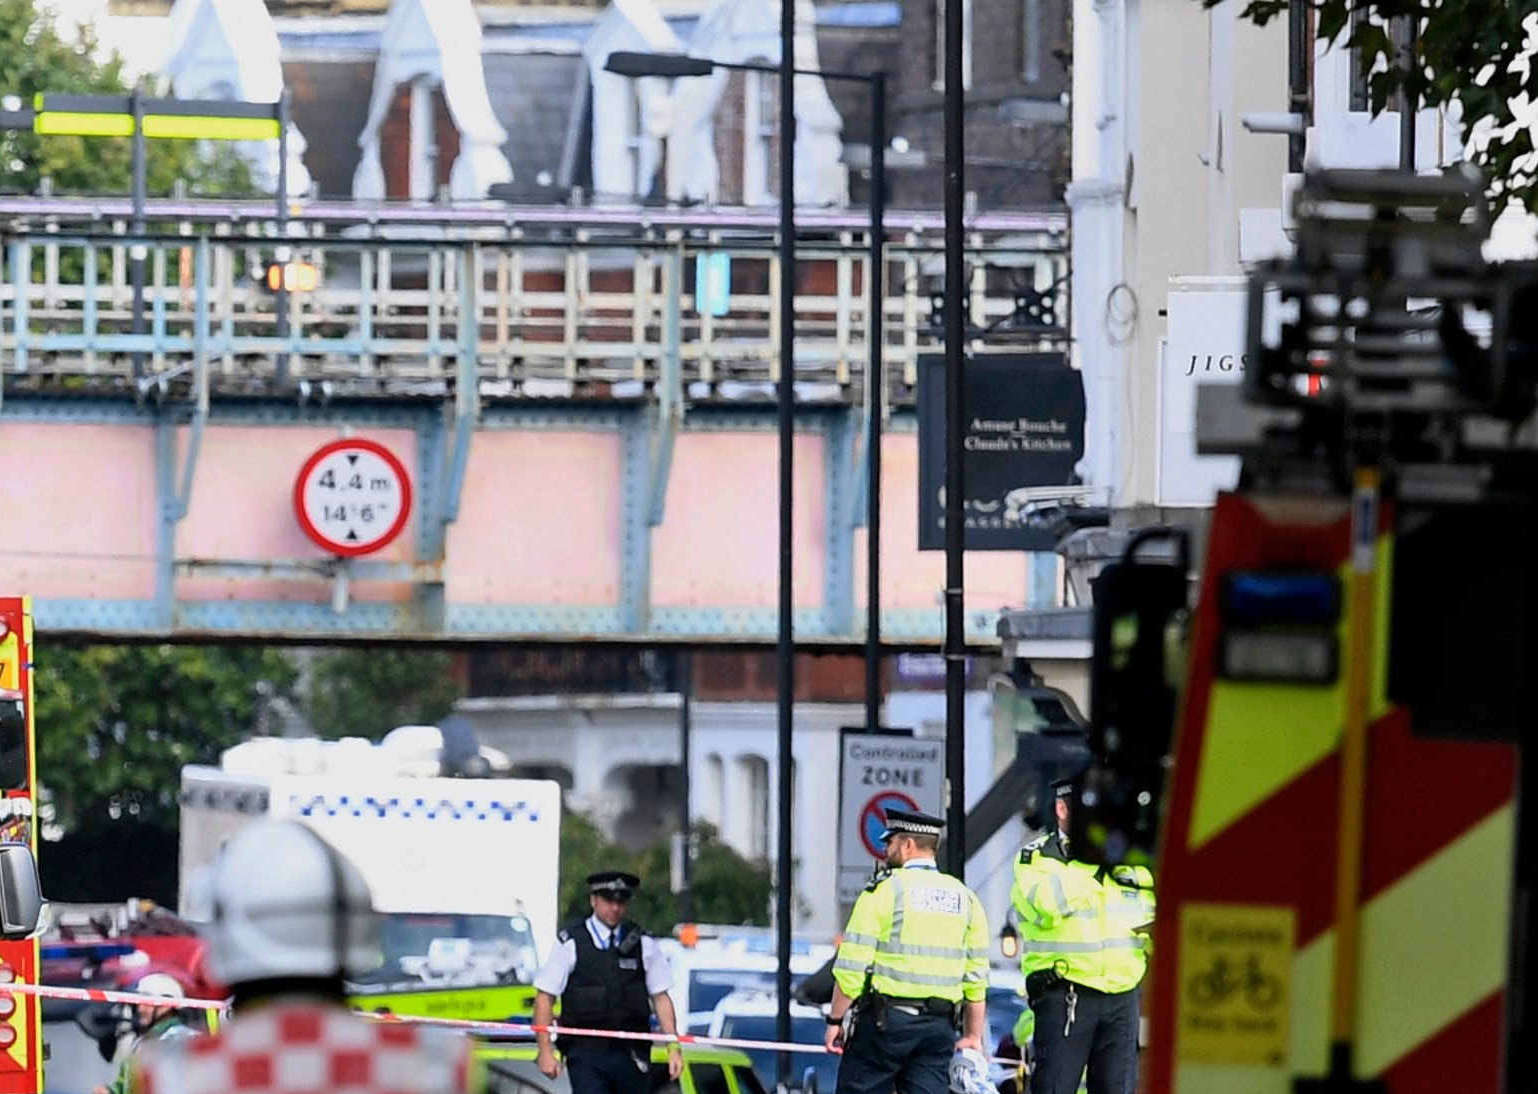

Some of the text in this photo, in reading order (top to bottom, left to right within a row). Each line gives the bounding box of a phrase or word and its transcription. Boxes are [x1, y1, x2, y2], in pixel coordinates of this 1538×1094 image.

[1186, 355, 1248, 376] JIGS
[1019, 418, 1067, 433] Bouche
[1021, 438, 1072, 451] Kitchen
[318, 469, 391, 490] 4.4 m
[849, 742, 940, 763] Controlled
[860, 766, 925, 787] ZONE
